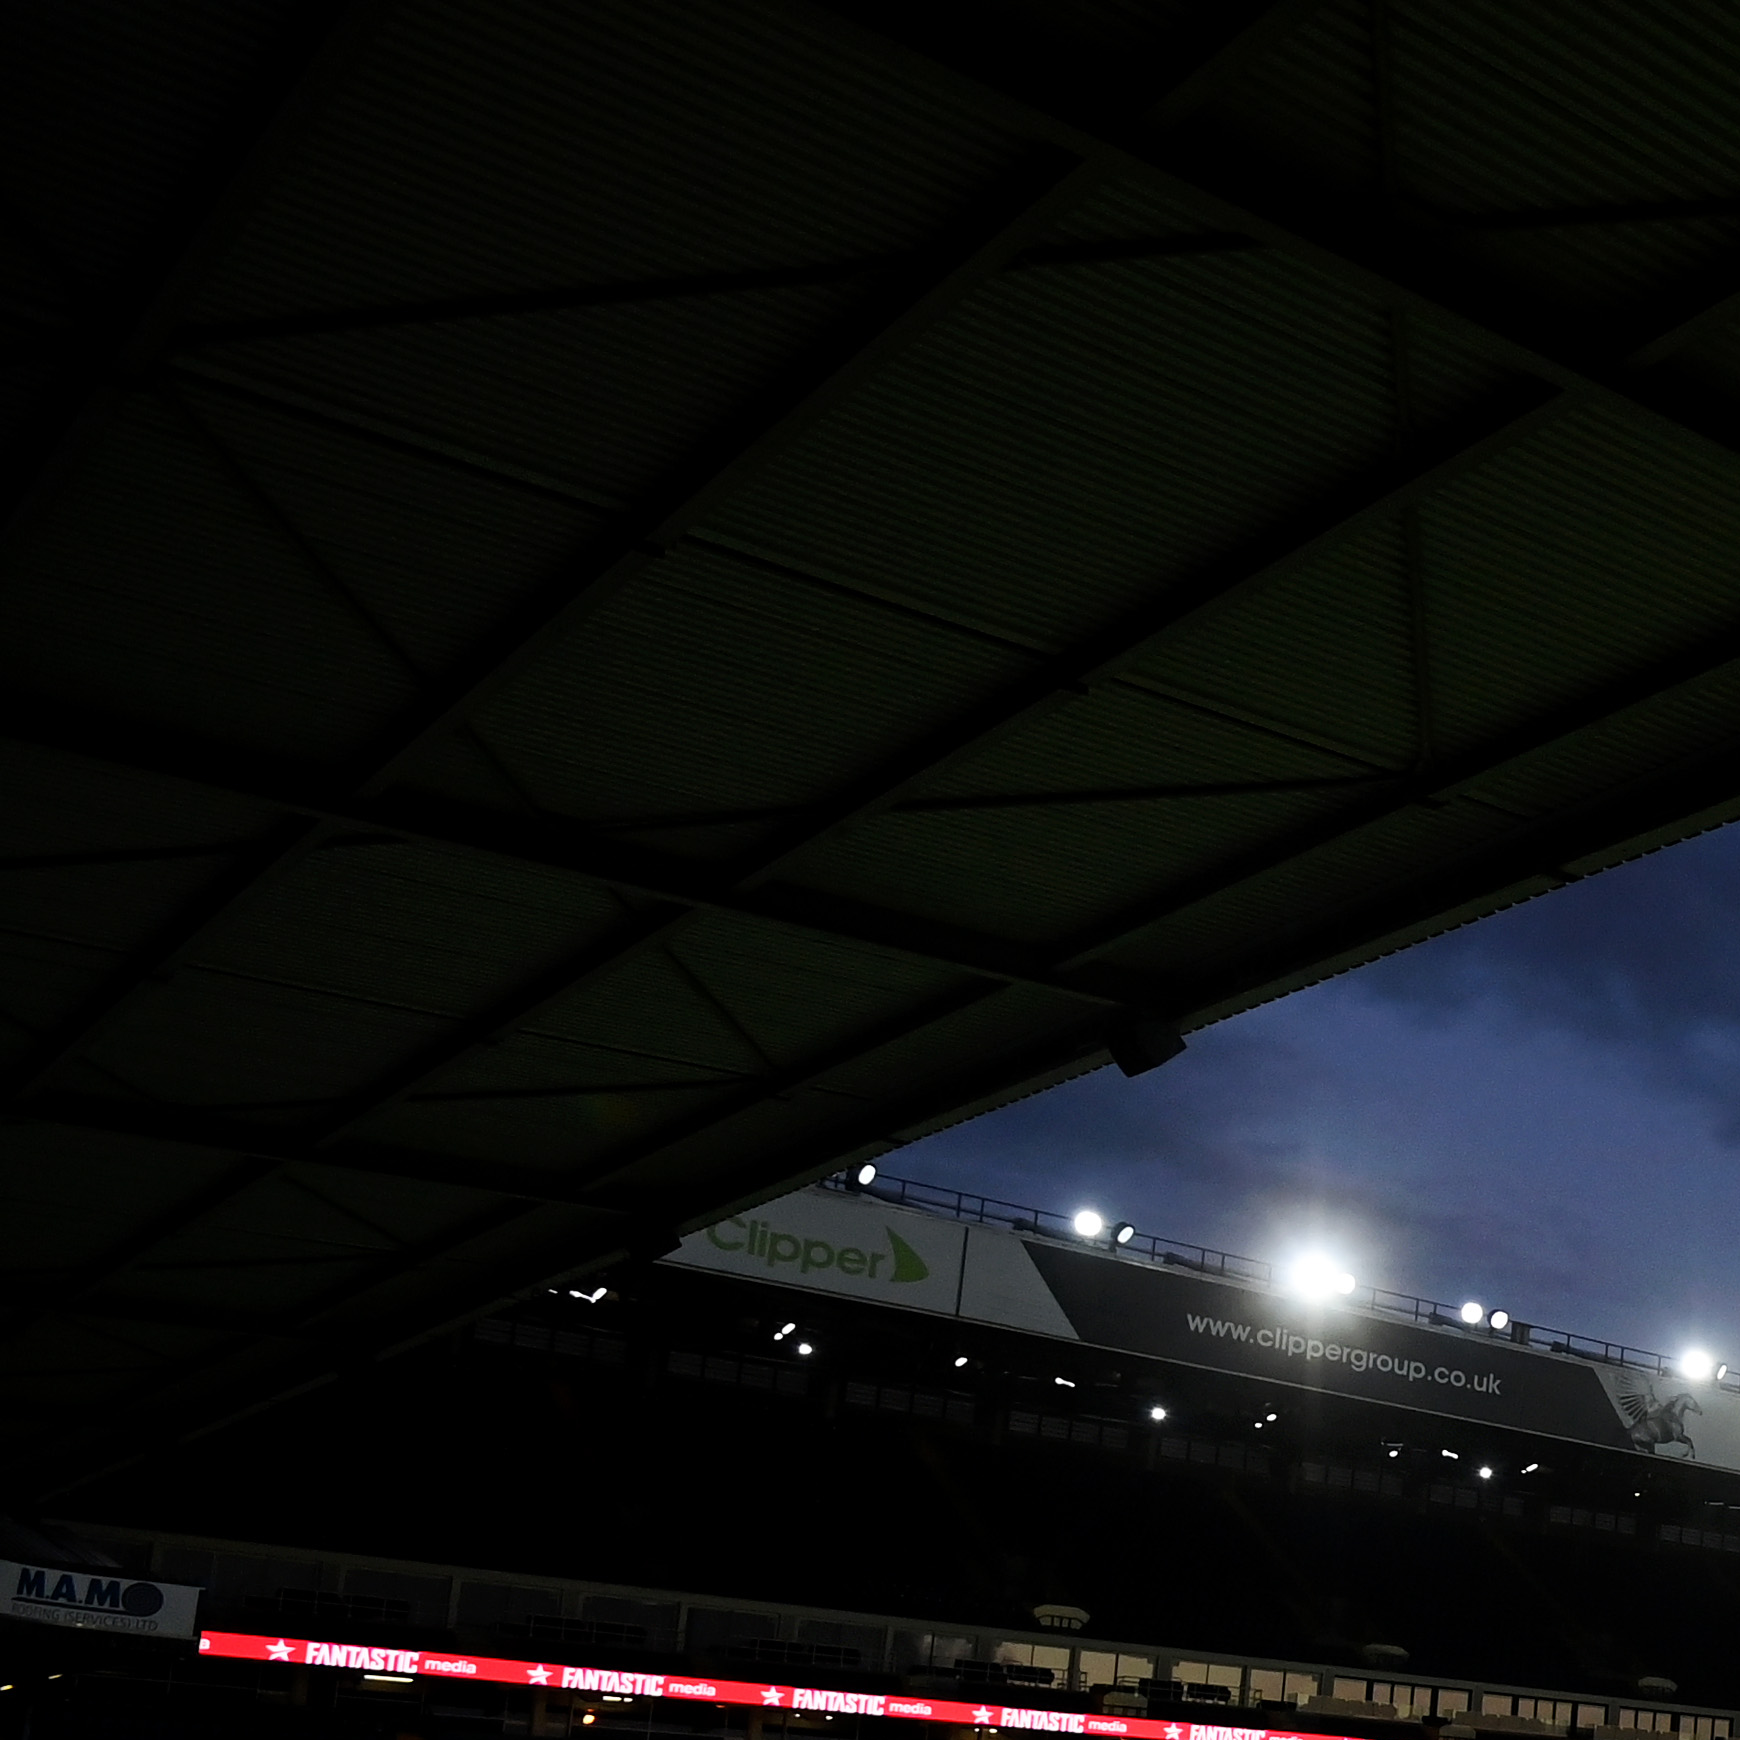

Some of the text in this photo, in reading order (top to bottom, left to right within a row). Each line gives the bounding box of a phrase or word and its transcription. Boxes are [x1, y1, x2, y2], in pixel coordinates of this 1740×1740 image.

[705, 1214, 889, 1282] Clipper
[1186, 1309, 1503, 1397] www.clippergroup.co.uk
[304, 1641, 477, 1675] FANTASTIC media
[561, 1667, 716, 1698] FANTASTIC media
[792, 1689, 933, 1716] FANTASTIC media
[1002, 1707, 1127, 1734] FANTASTIC media
